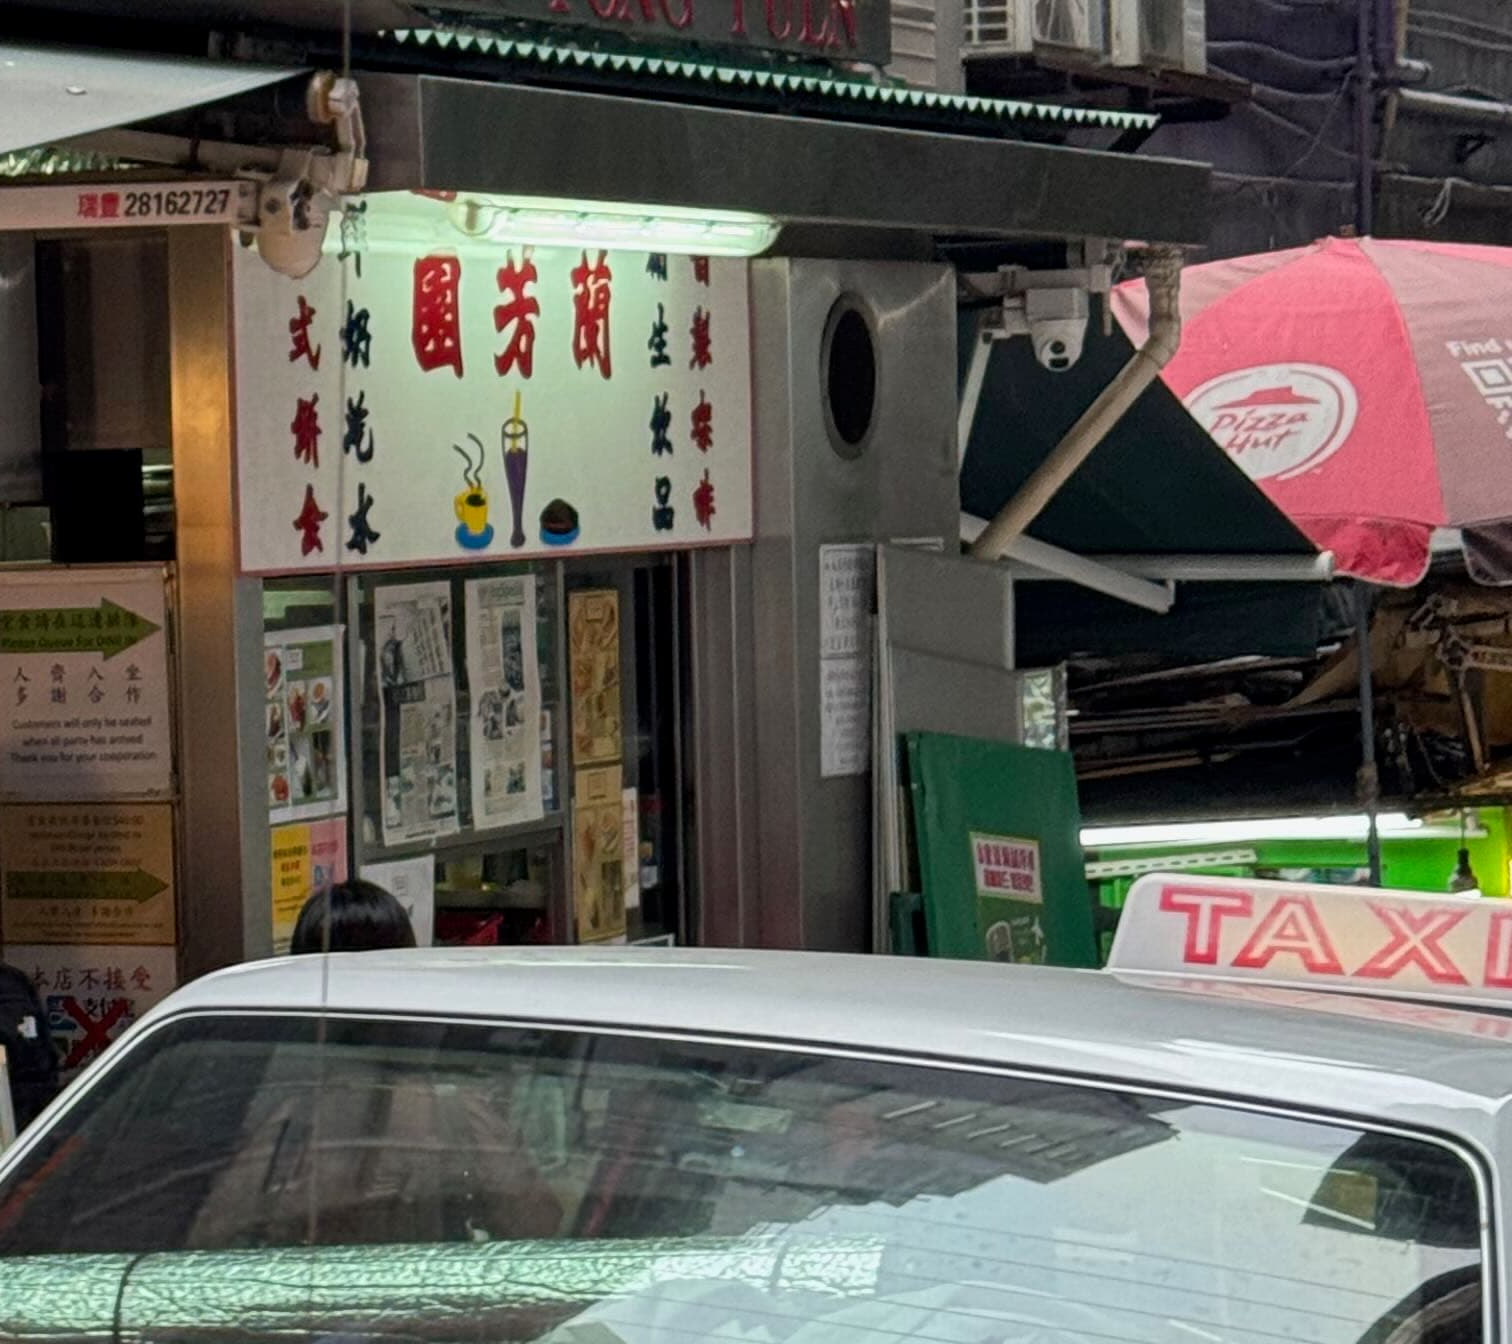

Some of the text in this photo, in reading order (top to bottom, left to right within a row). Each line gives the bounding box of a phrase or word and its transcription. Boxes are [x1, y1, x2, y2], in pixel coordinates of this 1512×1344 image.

[125, 189, 230, 217] 28162727
[1445, 338, 1503, 357] Find
[1211, 408, 1308, 434] Pizza
[1223, 431, 1303, 455] Hut
[1159, 884, 1512, 989] TAXI
[34, 965, 152, 991] 本店不接受
